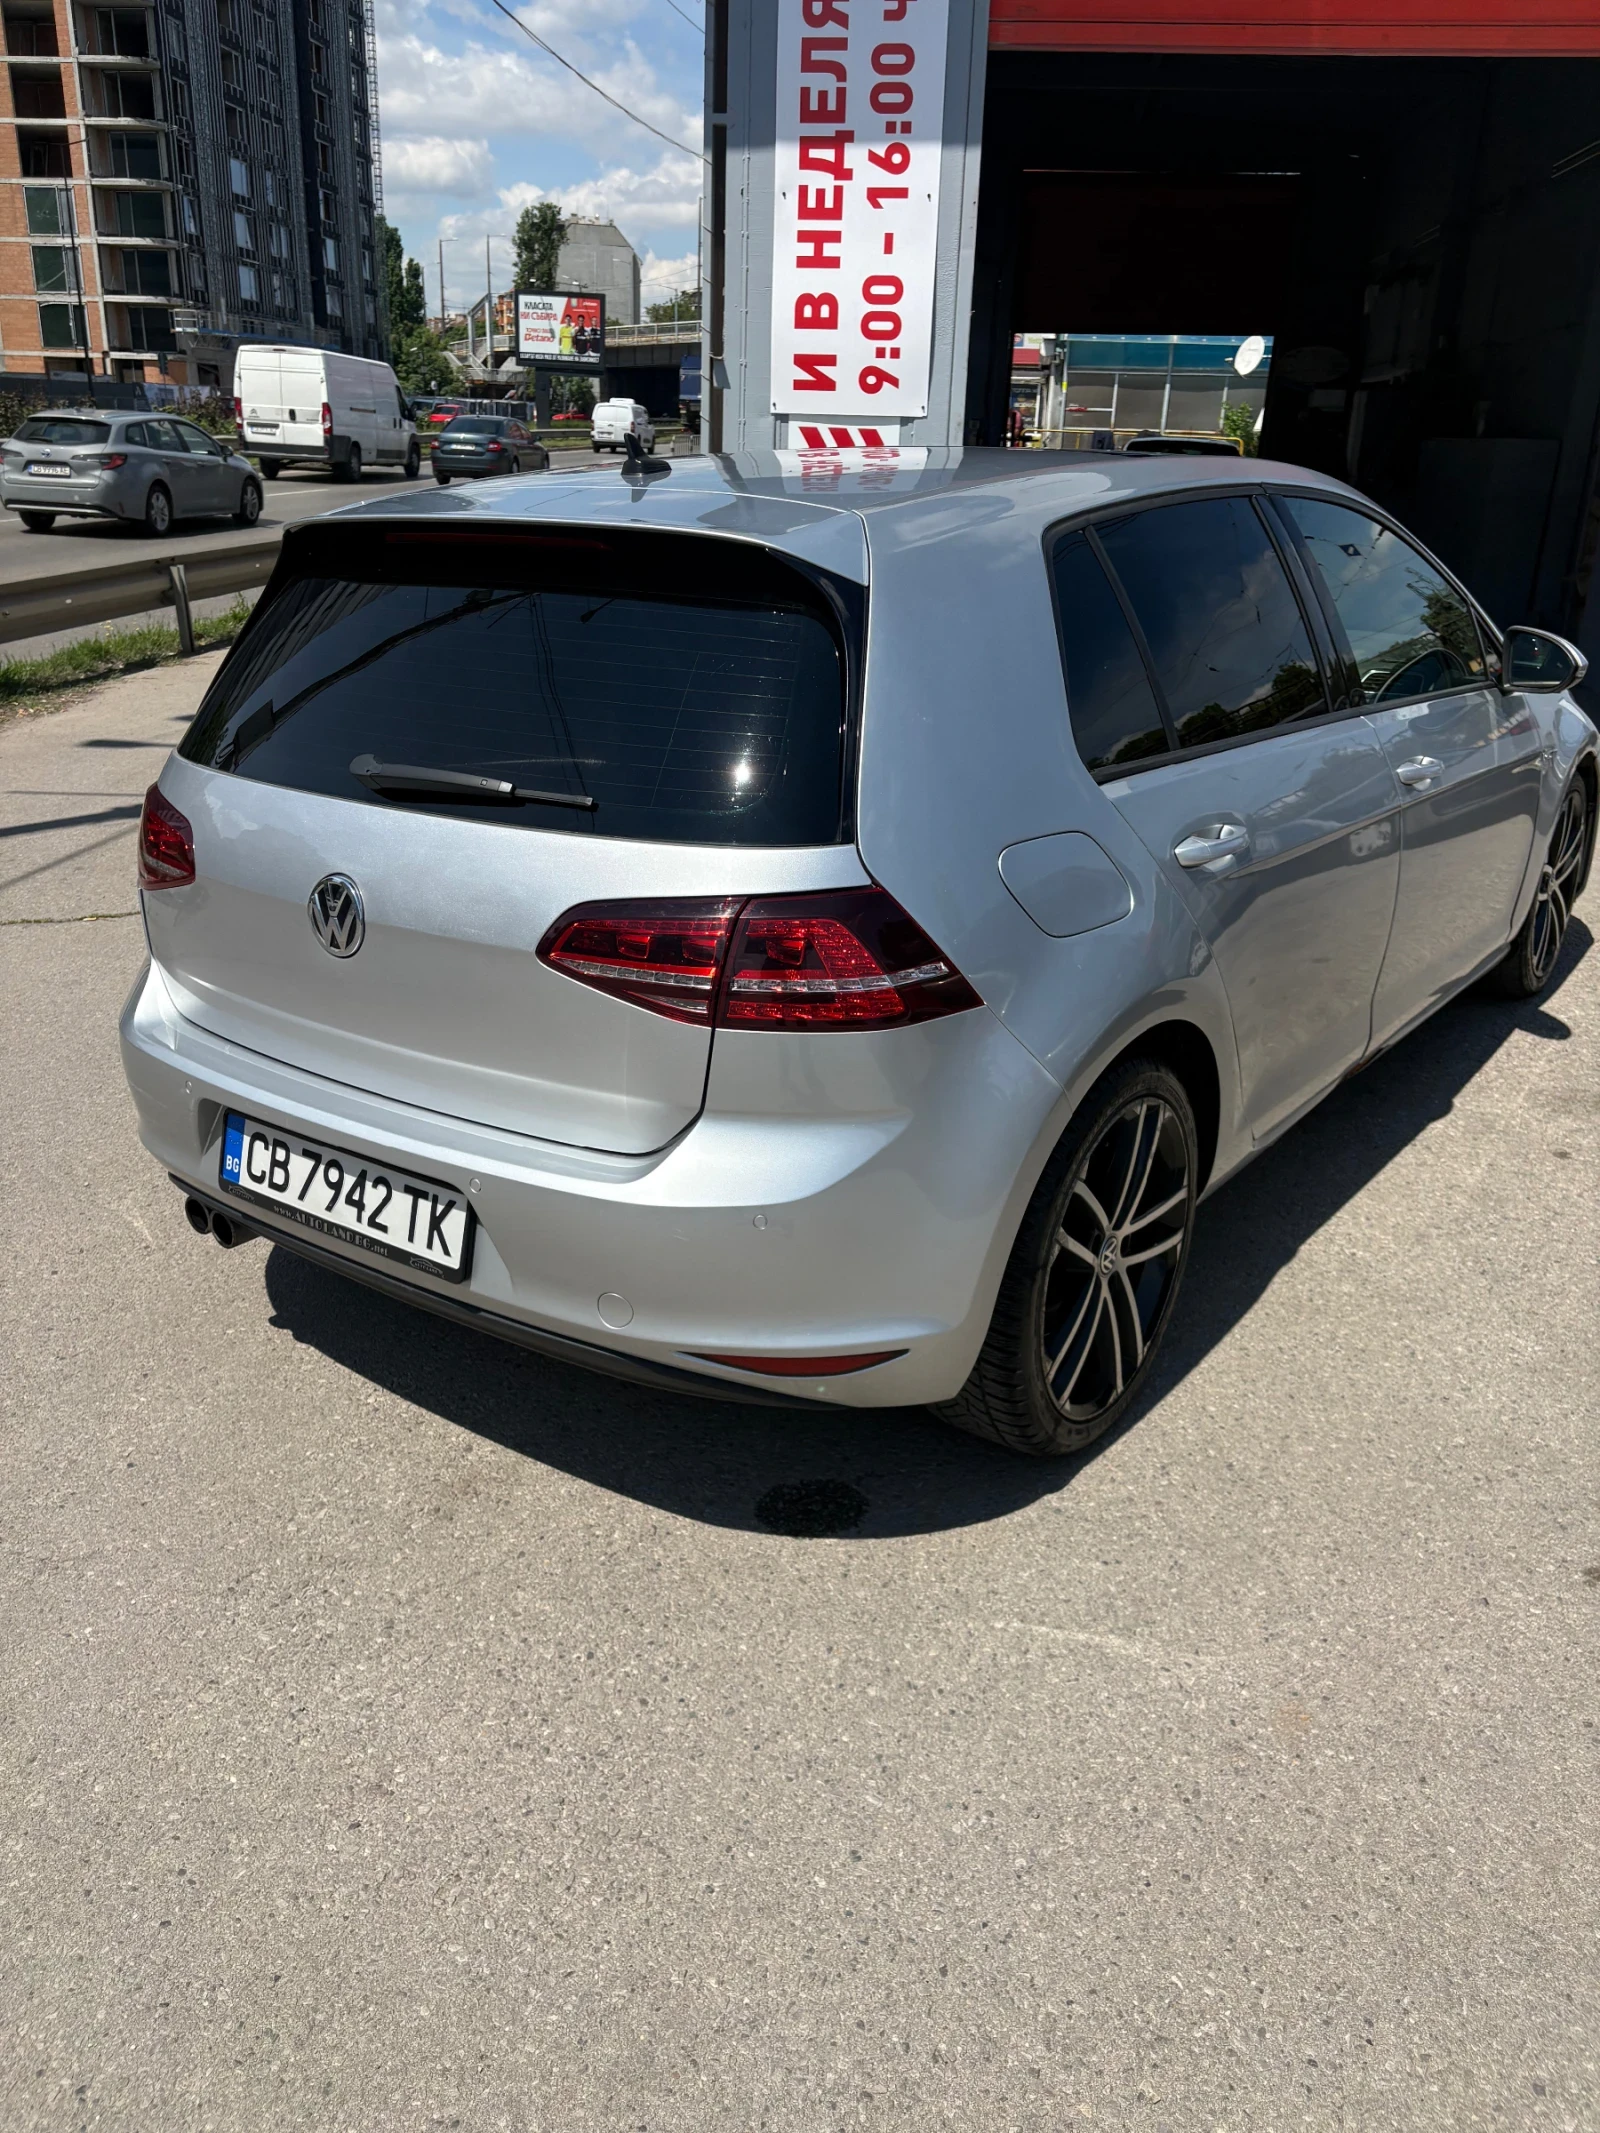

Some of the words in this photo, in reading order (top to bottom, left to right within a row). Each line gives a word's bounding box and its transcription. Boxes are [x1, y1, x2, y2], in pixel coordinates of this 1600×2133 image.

[796, 0, 855, 269] НЕДЕЛЯ
[866, 43, 916, 209] 16:00
[794, 292, 839, 330] В
[858, 275, 904, 395] 9:00
[793, 353, 837, 391] И
[225, 1154, 240, 1173] BG
